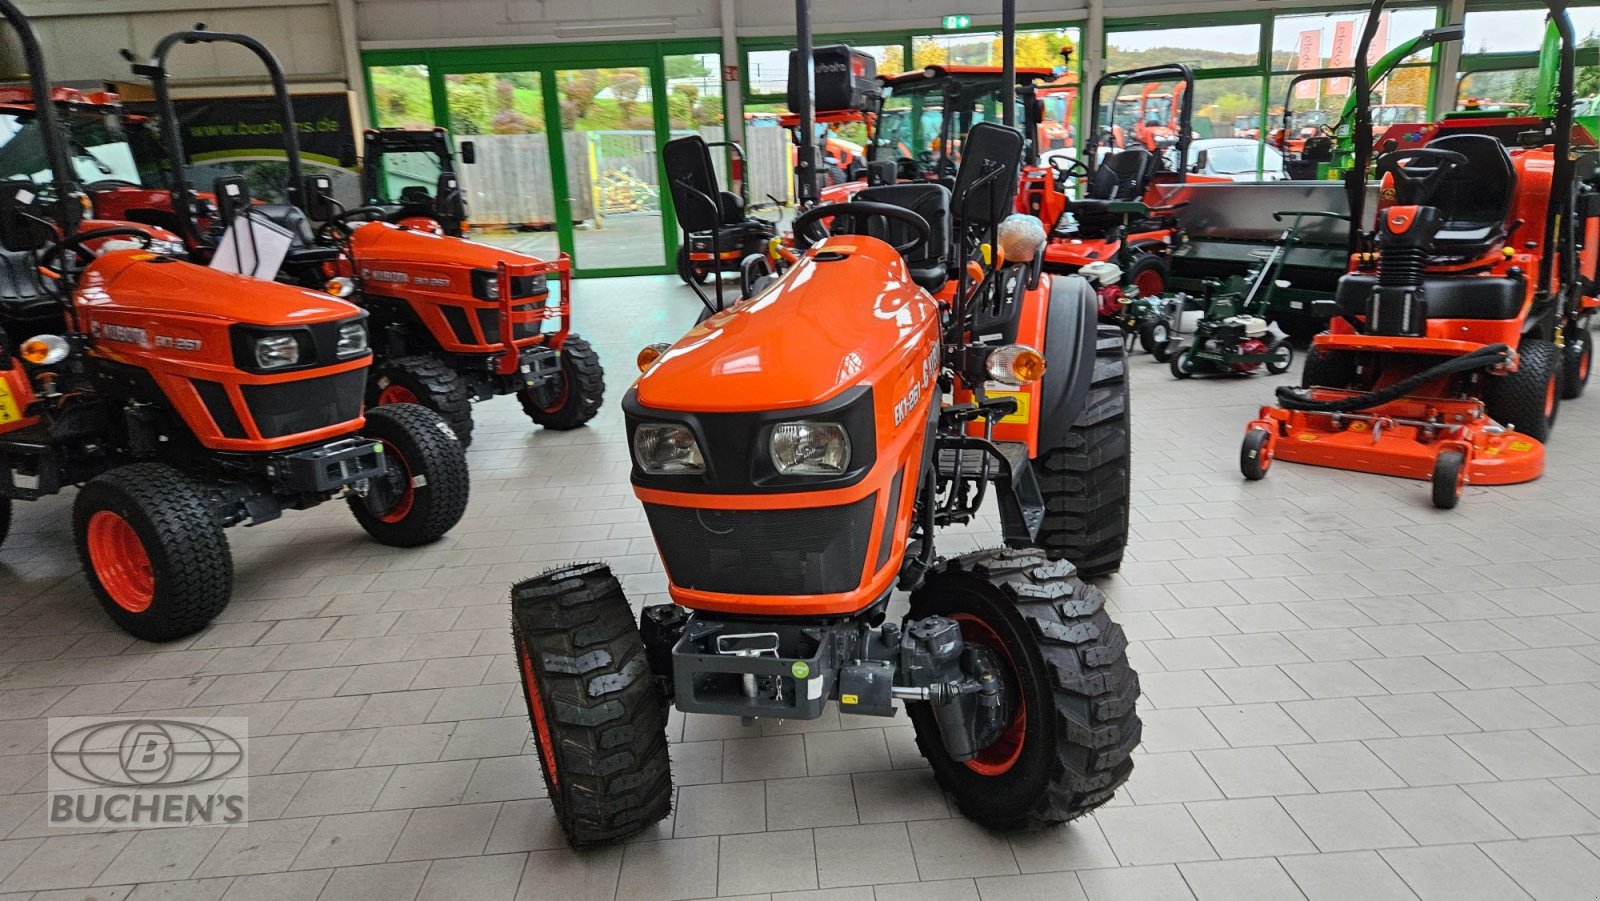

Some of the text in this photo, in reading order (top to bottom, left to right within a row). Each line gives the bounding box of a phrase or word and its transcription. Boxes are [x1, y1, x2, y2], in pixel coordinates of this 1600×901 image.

[815, 62, 847, 73] ubota
[191, 119, 339, 136] www.buchs.de
[894, 380, 921, 428] EK1-261
